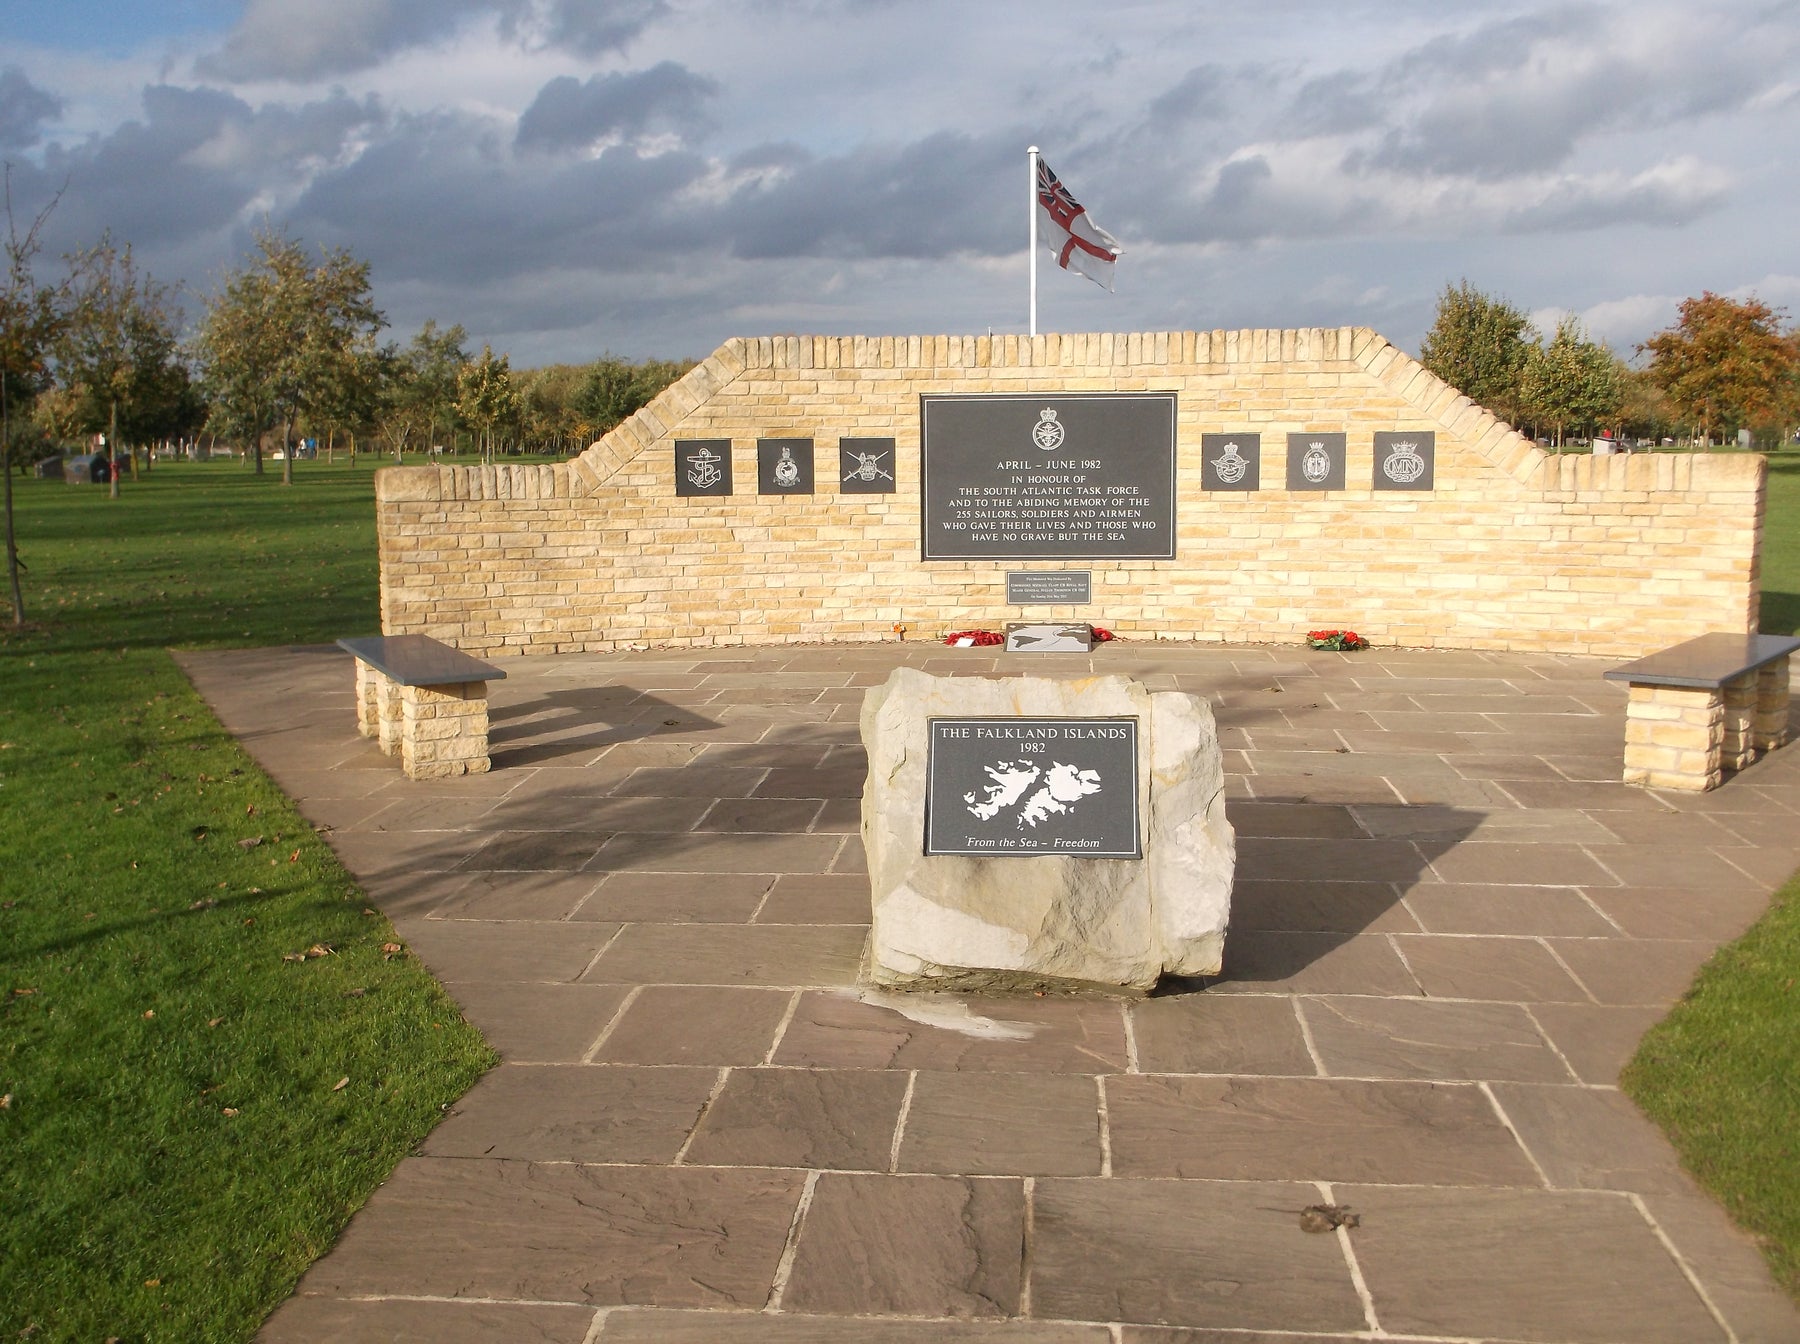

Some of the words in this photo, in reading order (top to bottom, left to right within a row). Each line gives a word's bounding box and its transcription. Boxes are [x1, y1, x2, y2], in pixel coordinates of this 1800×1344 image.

[997, 461, 1031, 470] APRIL
[1046, 461, 1076, 470] JUNE
[1081, 461, 1101, 470] 1982
[1390, 459, 1416, 474] MN
[959, 487, 979, 495] THE
[984, 487, 1016, 495] SOUTH
[1022, 487, 1073, 495] ATLANTIC
[1077, 487, 1101, 495] TASK
[1107, 487, 1139, 495] FORCE
[949, 499, 971, 507] AND
[976, 499, 988, 507] TO
[992, 499, 1012, 507] THE
[1017, 499, 1059, 507] ABIDING
[1064, 499, 1107, 507] MEMORY
[1112, 499, 1125, 507] OF
[1129, 499, 1150, 507] THE
[956, 510, 971, 518] 255
[975, 510, 1019, 518] SAILORS,
[1021, 510, 1069, 518] SOLDIERS
[1073, 510, 1095, 518] AND
[1099, 510, 1141, 518] AIRMEN
[943, 522, 966, 530] WHO
[970, 522, 996, 530] GAVE
[1000, 522, 1031, 530] THEIR
[1036, 522, 1065, 530] LIVES
[1069, 522, 1091, 530] AND
[1096, 522, 1127, 530] THOSE
[1132, 522, 1156, 530] WHO
[972, 533, 998, 541] HAVE
[1003, 533, 1016, 541] NO
[1021, 533, 1054, 541] GRAVE
[1058, 533, 1078, 541] BUT
[1083, 533, 1103, 541] THE
[1107, 533, 1125, 541] SEA
[940, 728, 970, 739] THE
[977, 728, 1057, 739] FALKLAND
[1064, 728, 1126, 739] ISLANDS
[1020, 743, 1045, 752] 1982
[1000, 838, 1015, 847] the
[1019, 837, 1037, 847] Sea
